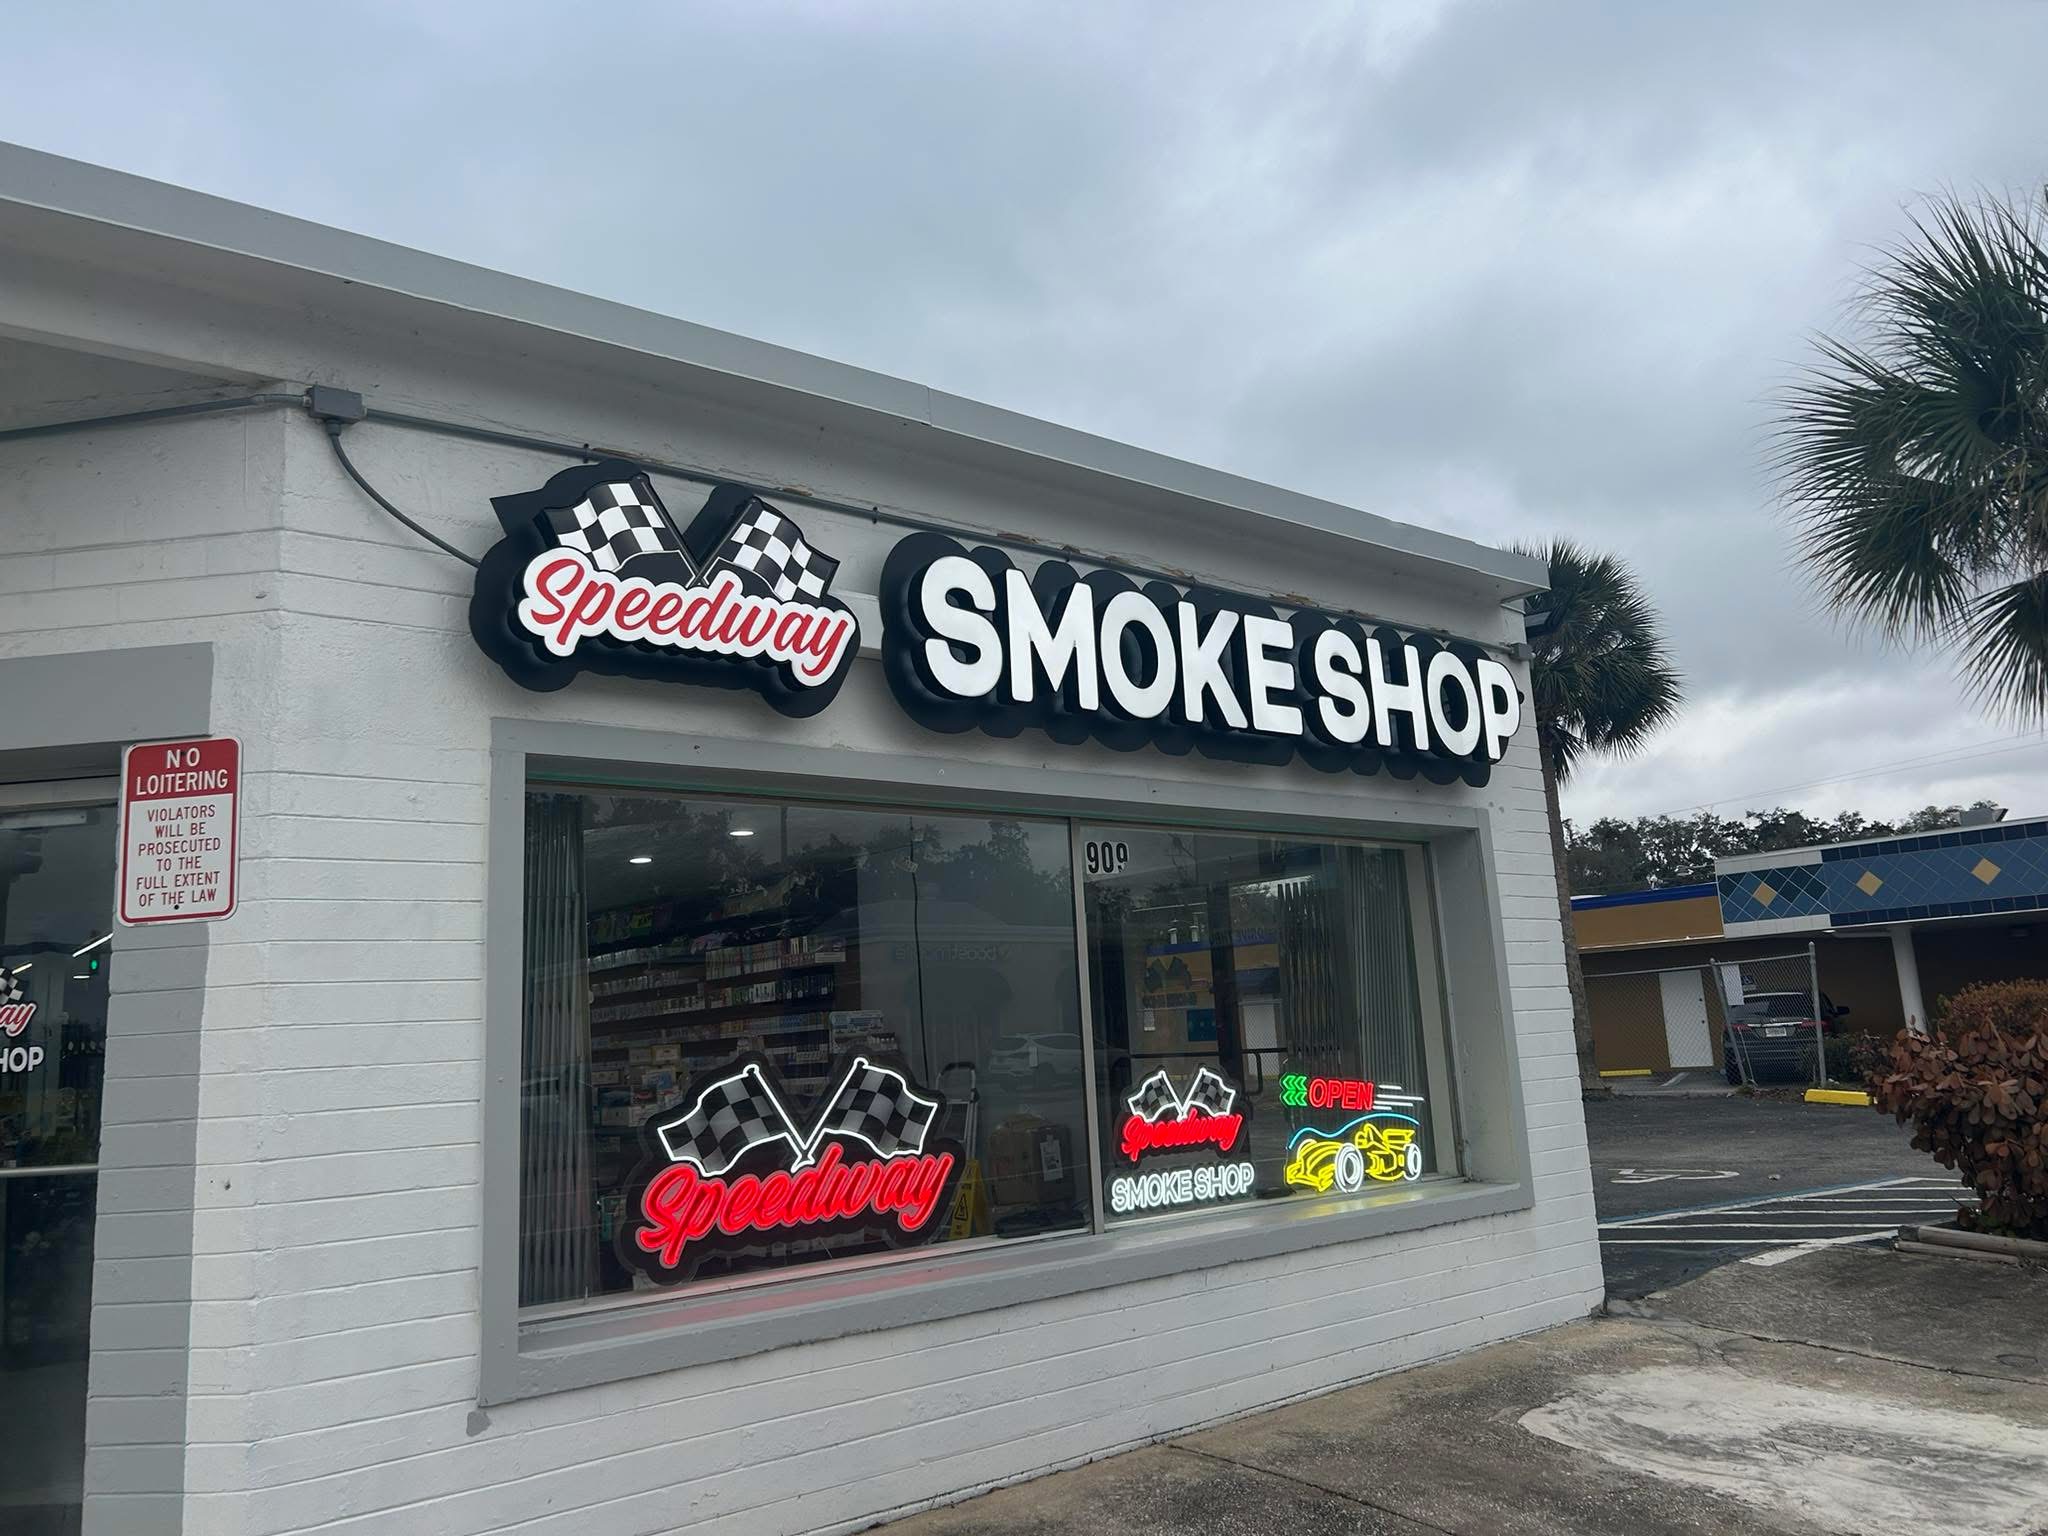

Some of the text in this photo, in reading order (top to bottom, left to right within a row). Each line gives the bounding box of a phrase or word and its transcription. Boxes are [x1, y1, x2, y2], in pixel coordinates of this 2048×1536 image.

[530, 557, 849, 677] Speedway
[920, 555, 1521, 761] SMOKE SHOP
[166, 747, 200, 769] NO
[136, 769, 229, 796] LOITERING
[147, 804, 216, 822] VIOLATORS
[155, 822, 207, 838] WILL BE
[138, 837, 221, 856] PROSECUTED
[156, 856, 202, 872] TO THE
[136, 871, 220, 891] FULL EXTENT
[139, 888, 217, 908] OF THE LAW
[1308, 1077, 1374, 1111] OPEN
[1121, 1107, 1243, 1162] Speedway
[1111, 1163, 1255, 1212] SMOKE SHOP
[635, 1142, 954, 1268] Speedway
